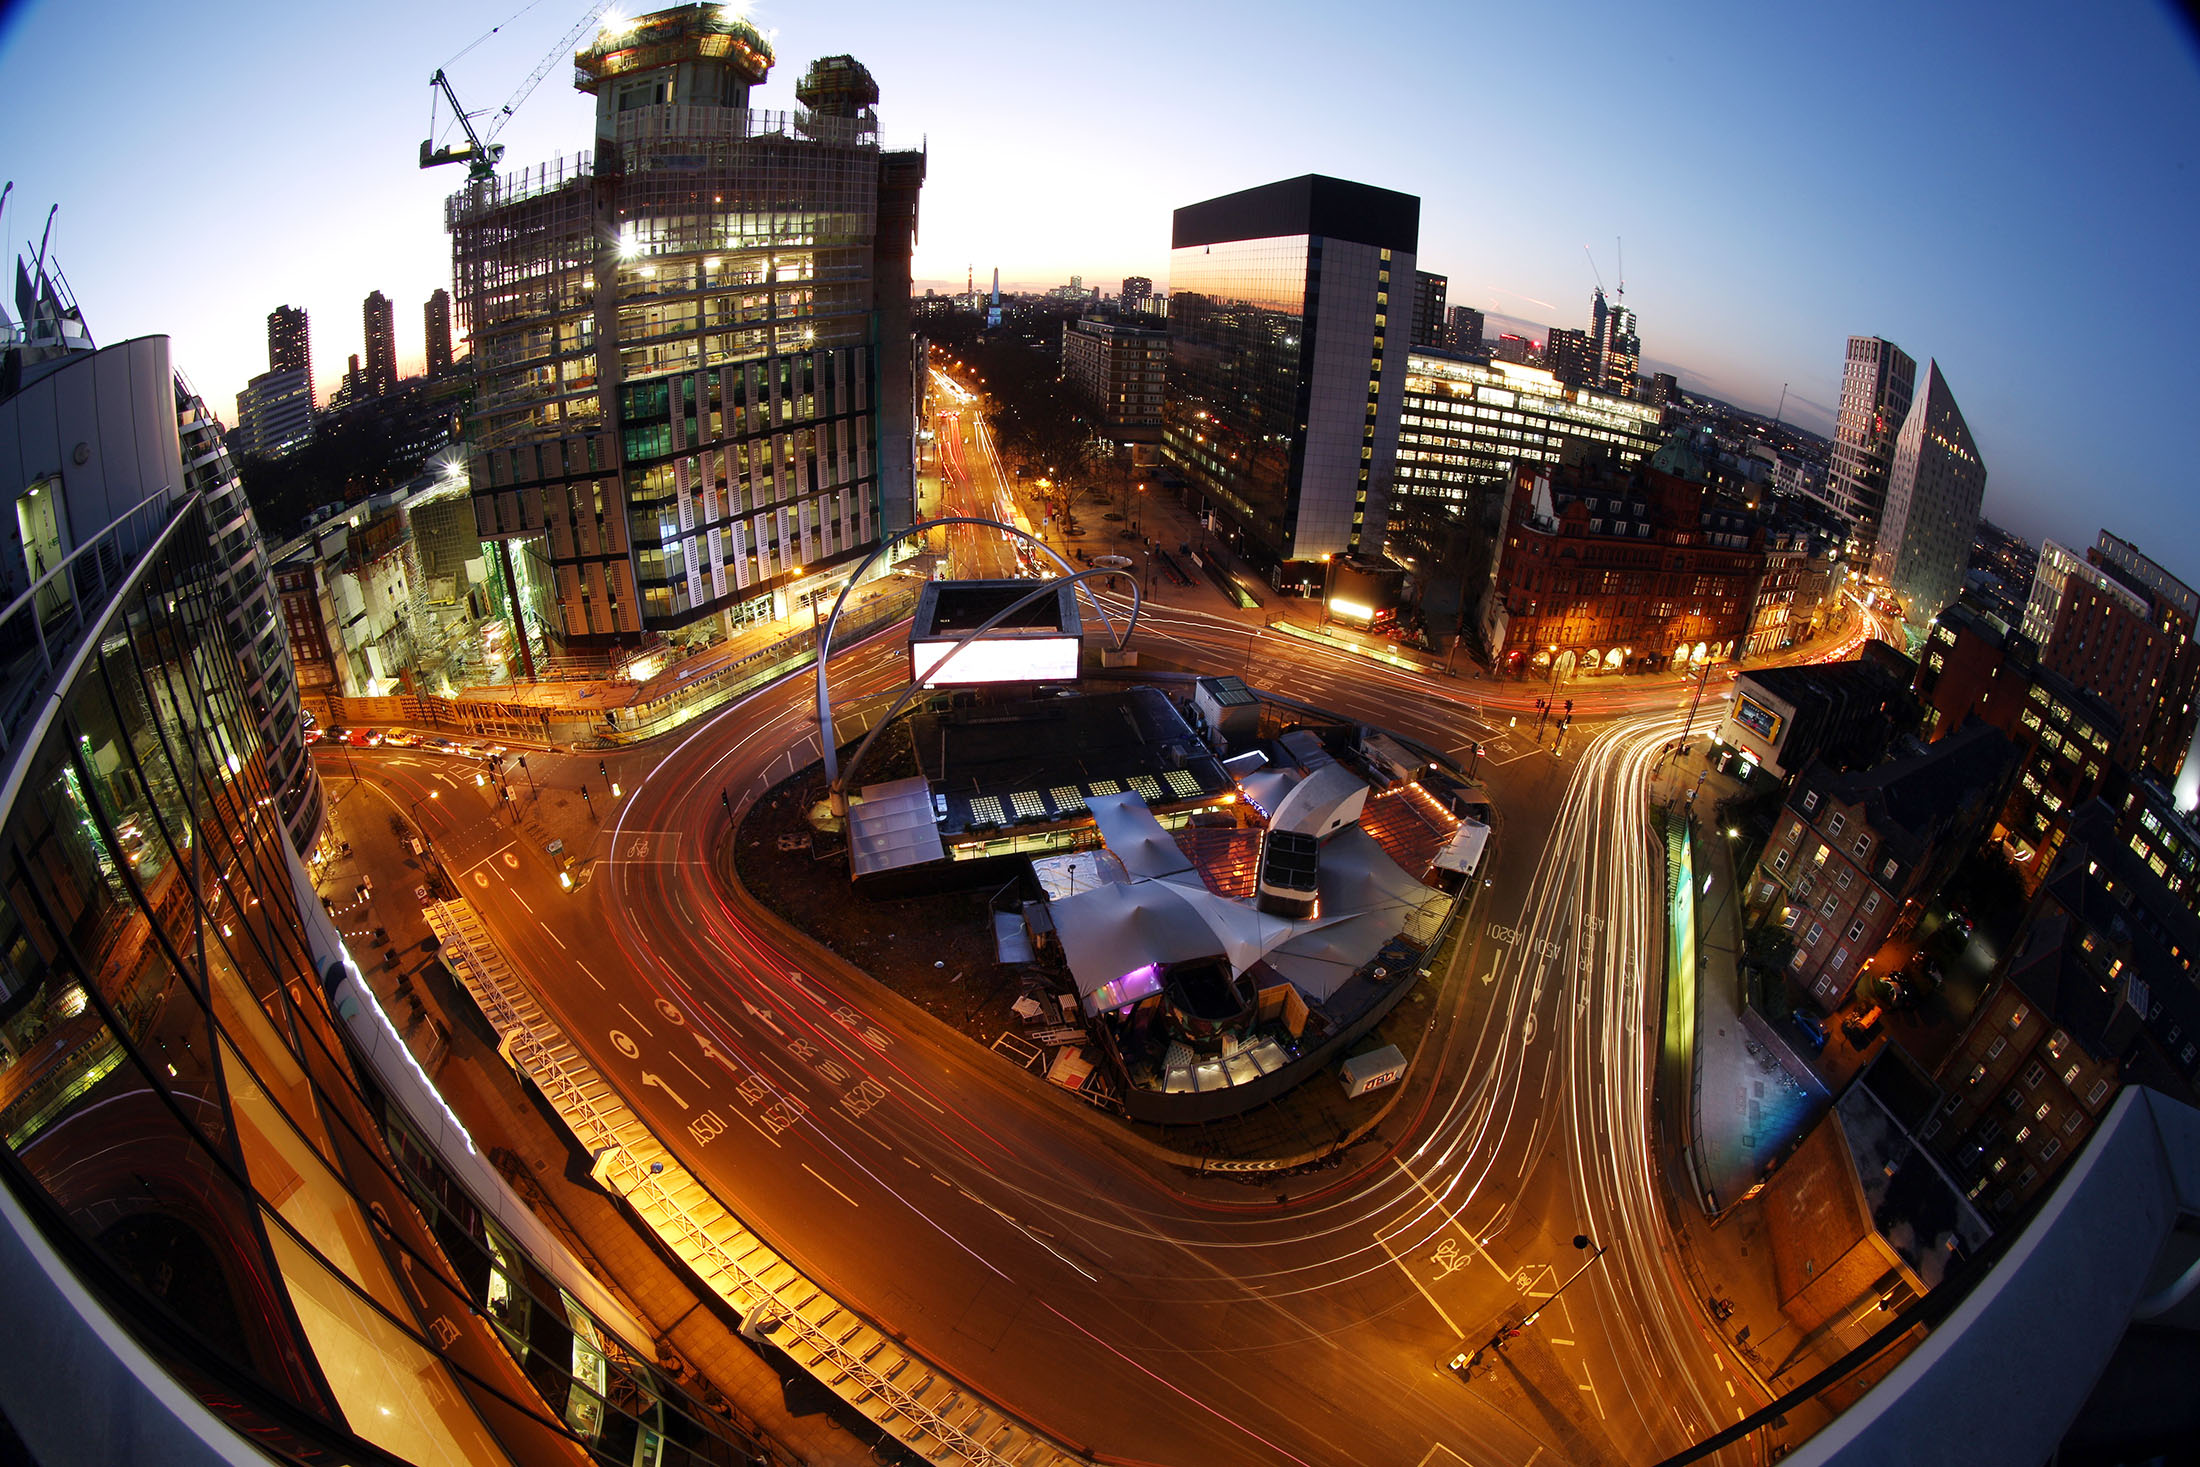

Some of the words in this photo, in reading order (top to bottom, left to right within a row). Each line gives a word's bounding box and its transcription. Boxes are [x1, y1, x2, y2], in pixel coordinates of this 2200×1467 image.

[829, 1006, 863, 1030] RR
[786, 1038, 820, 1062] RR
[735, 1071, 776, 1106] A501
[839, 1075, 891, 1119] A5201
[687, 1109, 728, 1147] A501
[759, 1092, 810, 1135] A5201
